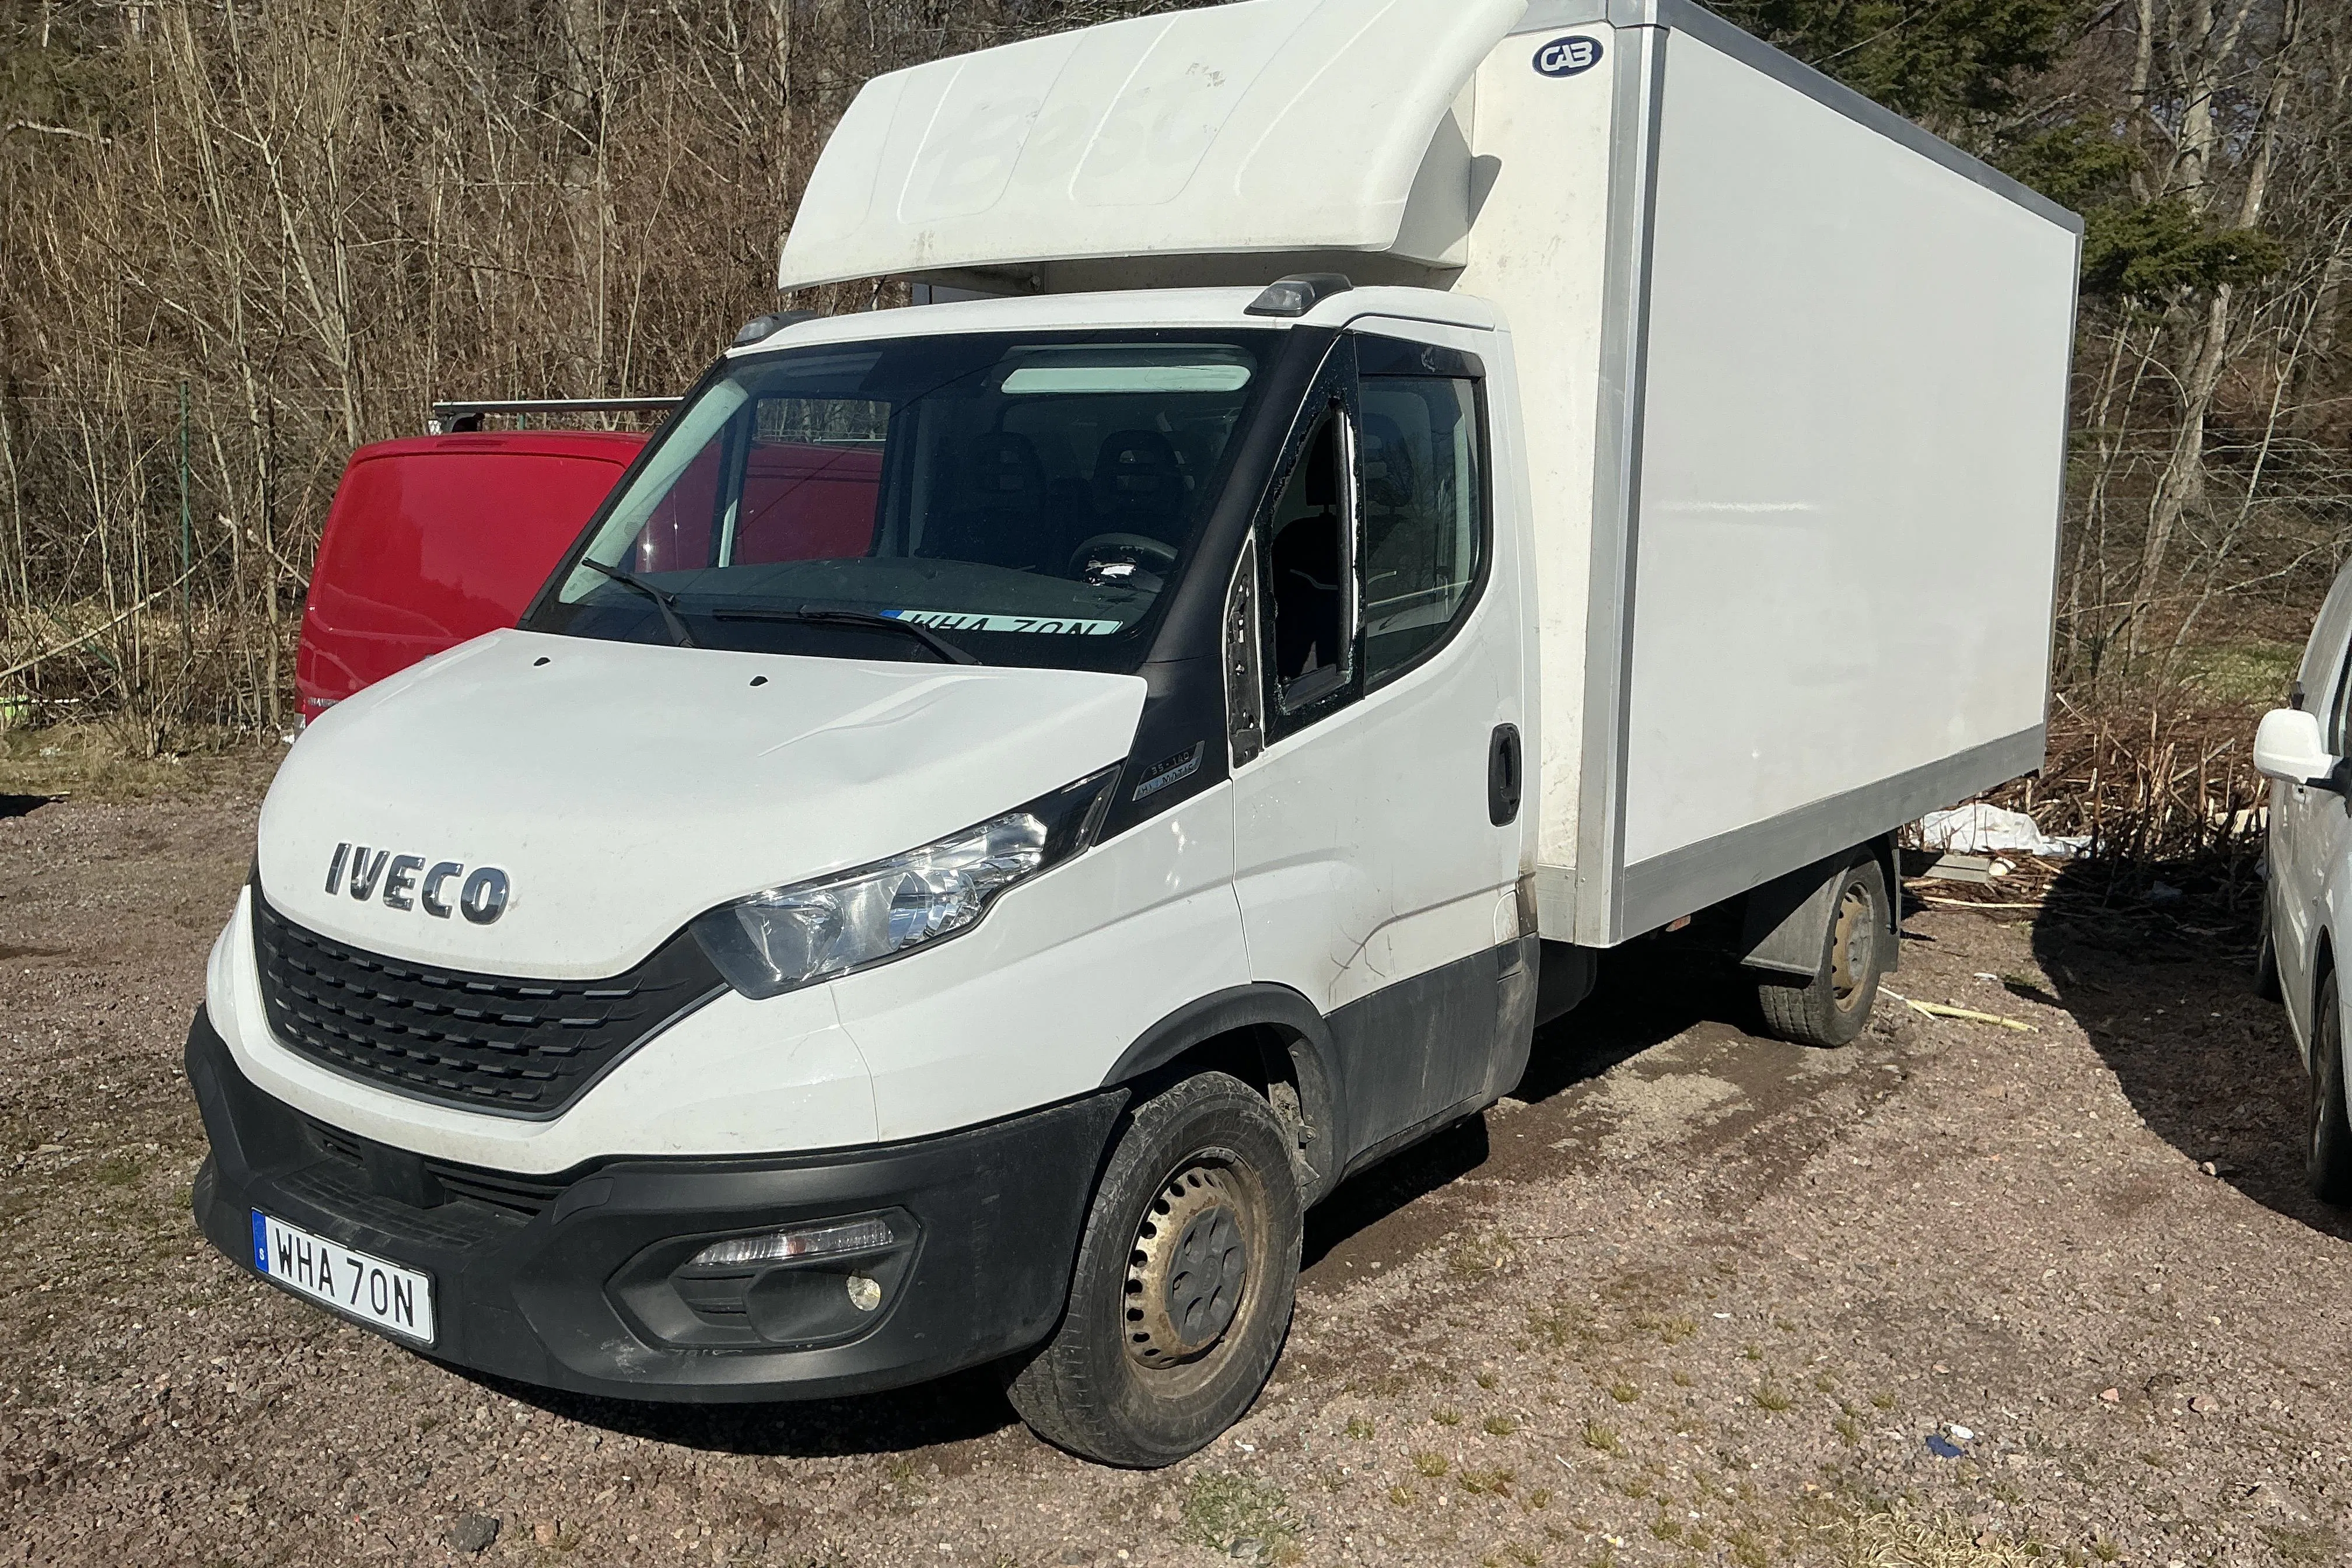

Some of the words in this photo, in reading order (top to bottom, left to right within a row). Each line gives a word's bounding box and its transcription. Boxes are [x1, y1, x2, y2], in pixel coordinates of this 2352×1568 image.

[1541, 41, 1593, 72] CAB
[910, 614, 990, 631] WHA
[324, 842, 511, 925] IVECO
[259, 1247, 265, 1261] S
[275, 1227, 335, 1298] WHA
